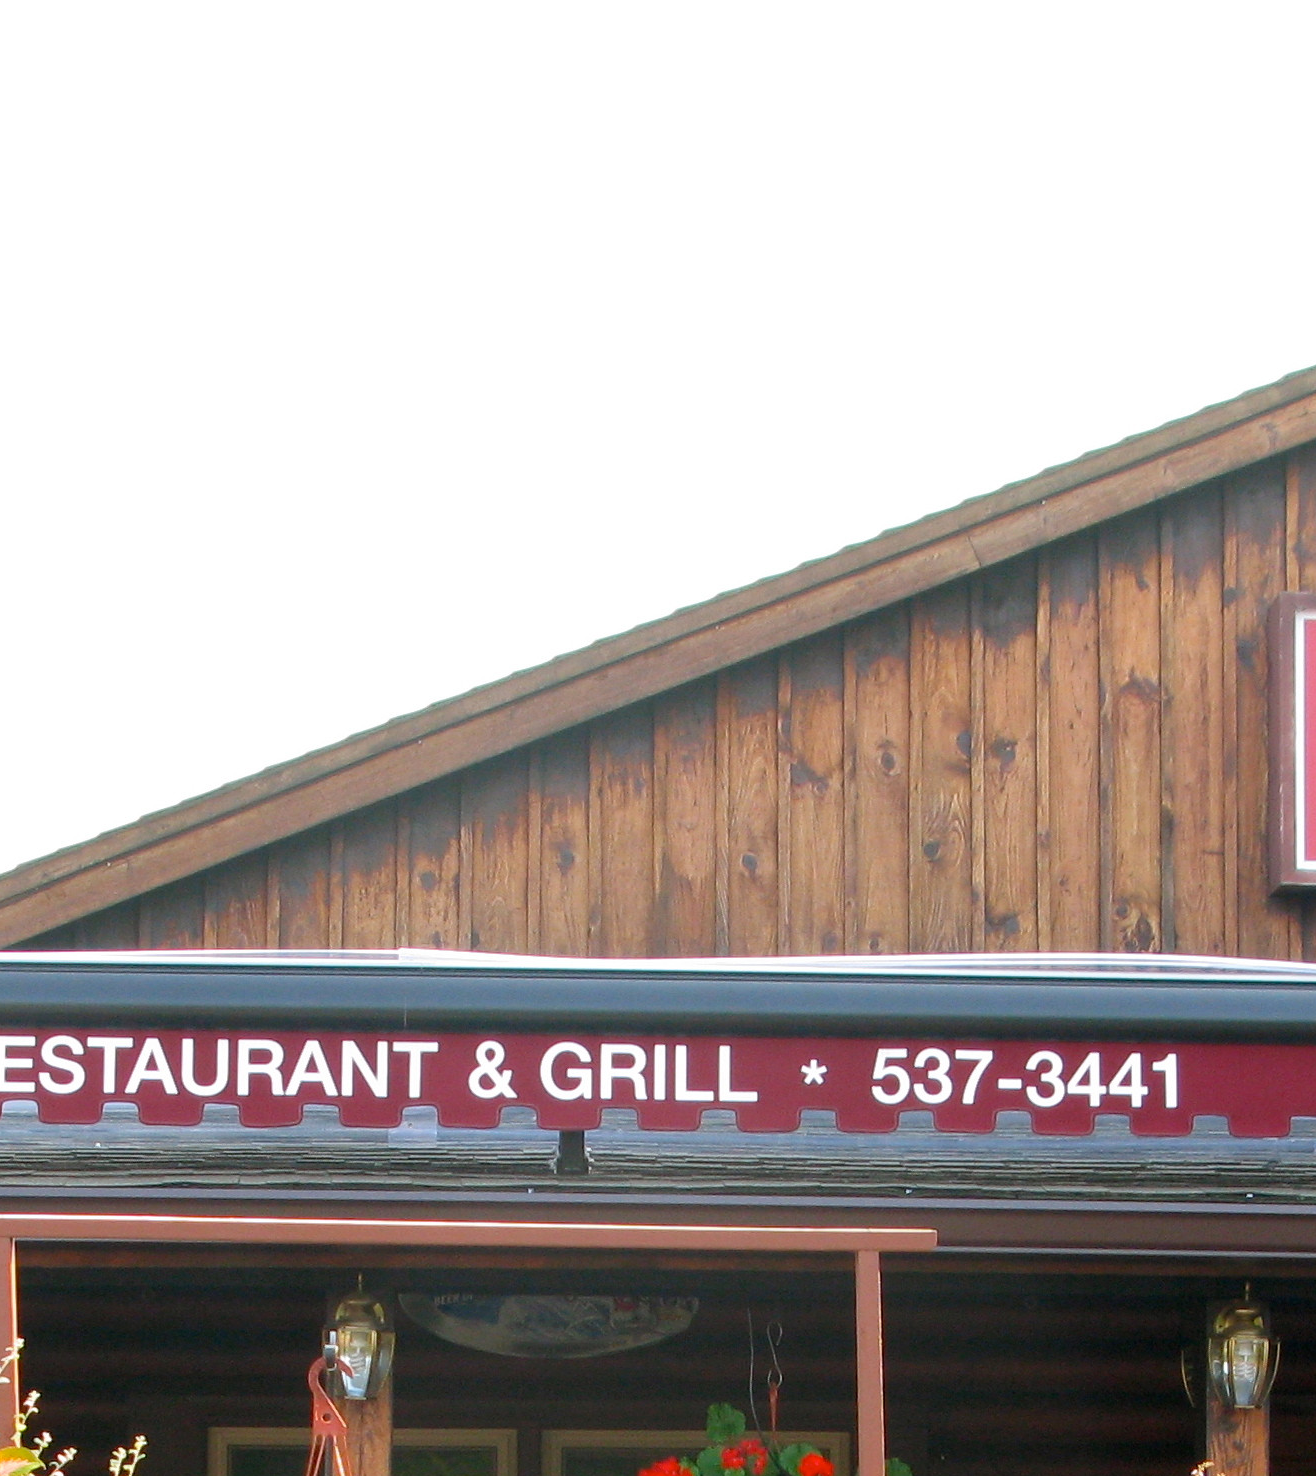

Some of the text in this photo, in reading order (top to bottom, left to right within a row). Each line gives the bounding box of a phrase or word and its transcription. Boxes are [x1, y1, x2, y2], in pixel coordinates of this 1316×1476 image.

[468, 1040, 518, 1100] &
[539, 1041, 759, 1103] GRILL
[871, 1047, 1179, 1108] 537-3441
